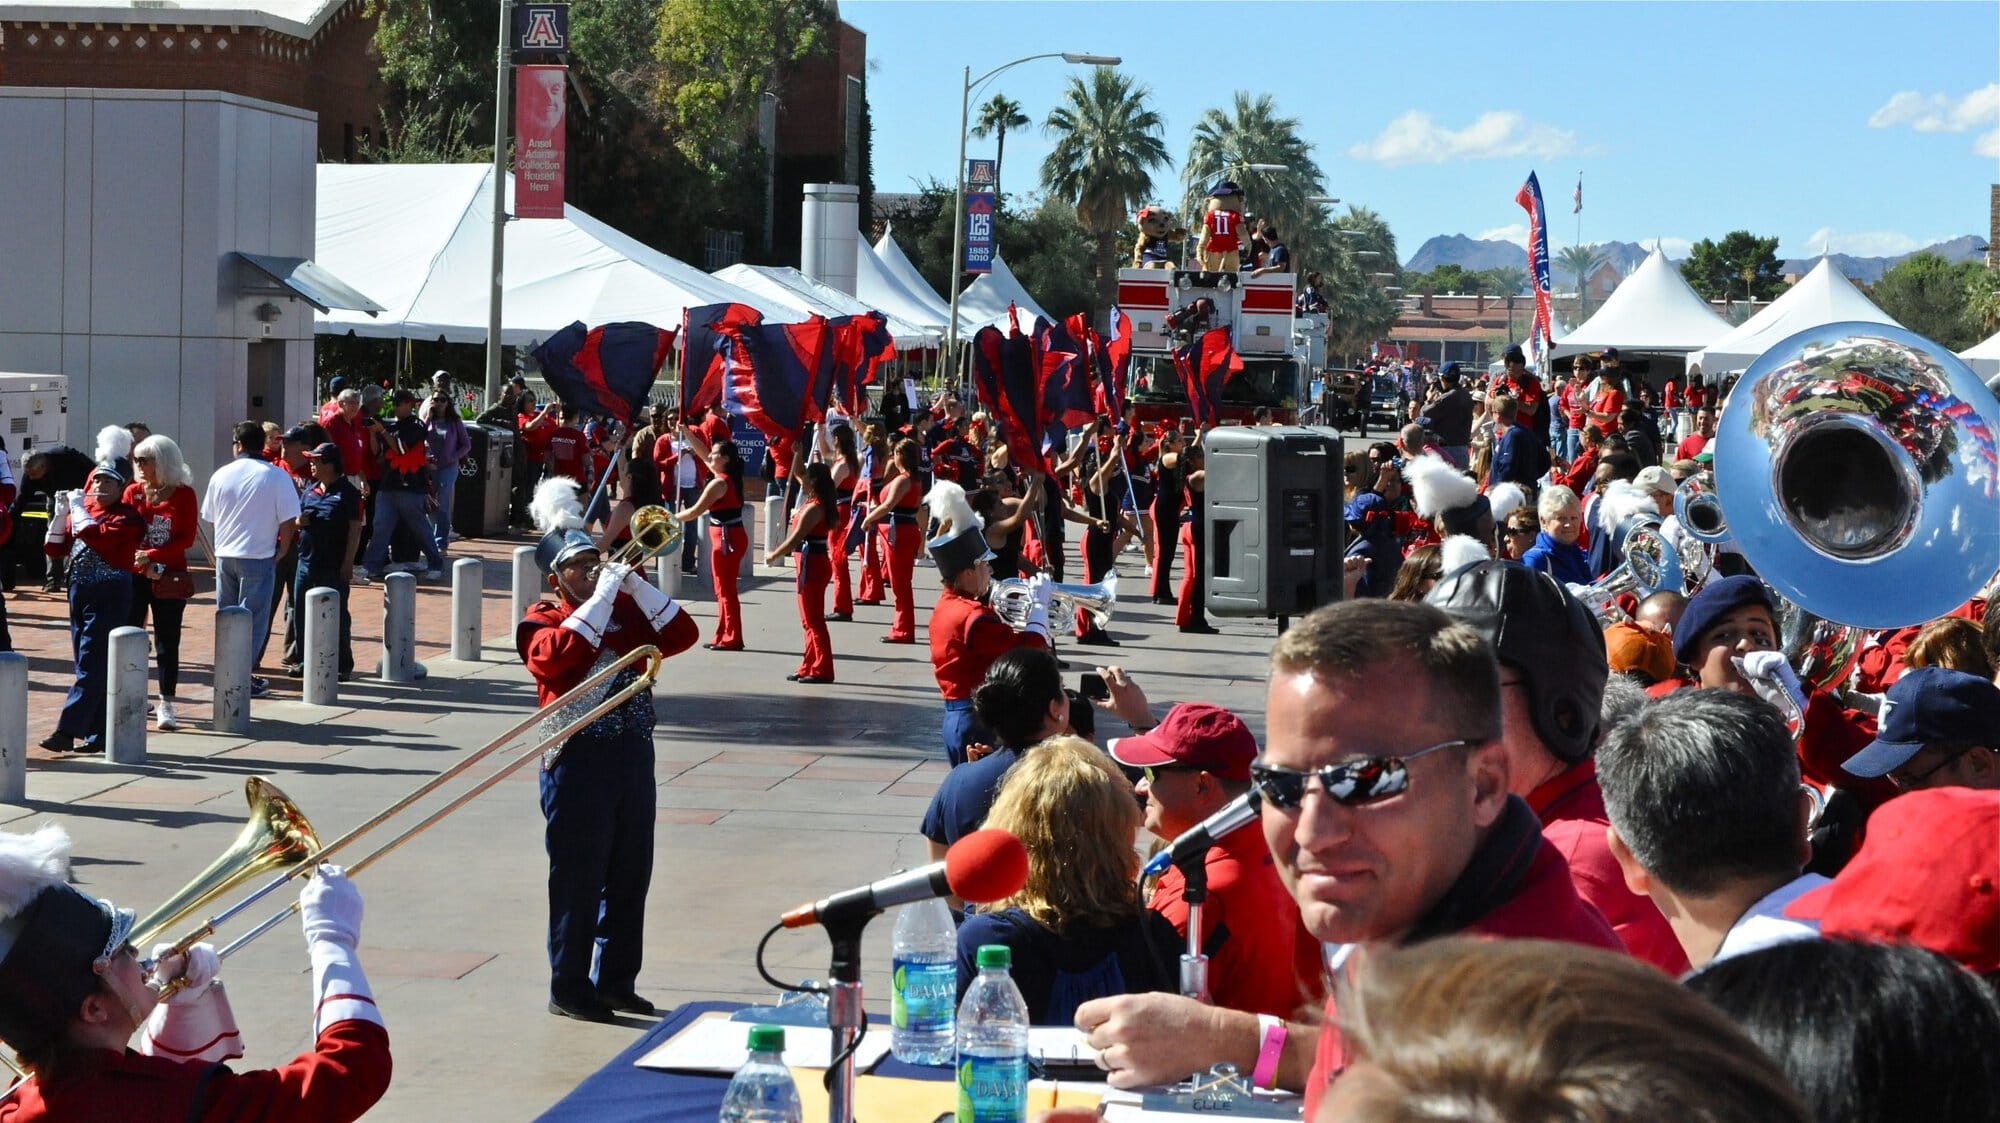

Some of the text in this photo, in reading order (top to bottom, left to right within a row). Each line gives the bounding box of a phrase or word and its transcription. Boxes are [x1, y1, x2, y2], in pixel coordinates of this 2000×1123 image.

[522, 9, 563, 48] A
[528, 138, 552, 148] Ansel
[525, 149, 556, 159] Adams
[520, 160, 560, 170] Collection
[524, 171, 555, 180] Housed
[970, 162, 993, 183] A
[529, 182, 549, 192] Here
[969, 213, 990, 236] 125
[1215, 216, 1229, 234] 11
[969, 247, 989, 255] 1885
[969, 254, 989, 262] 2010
